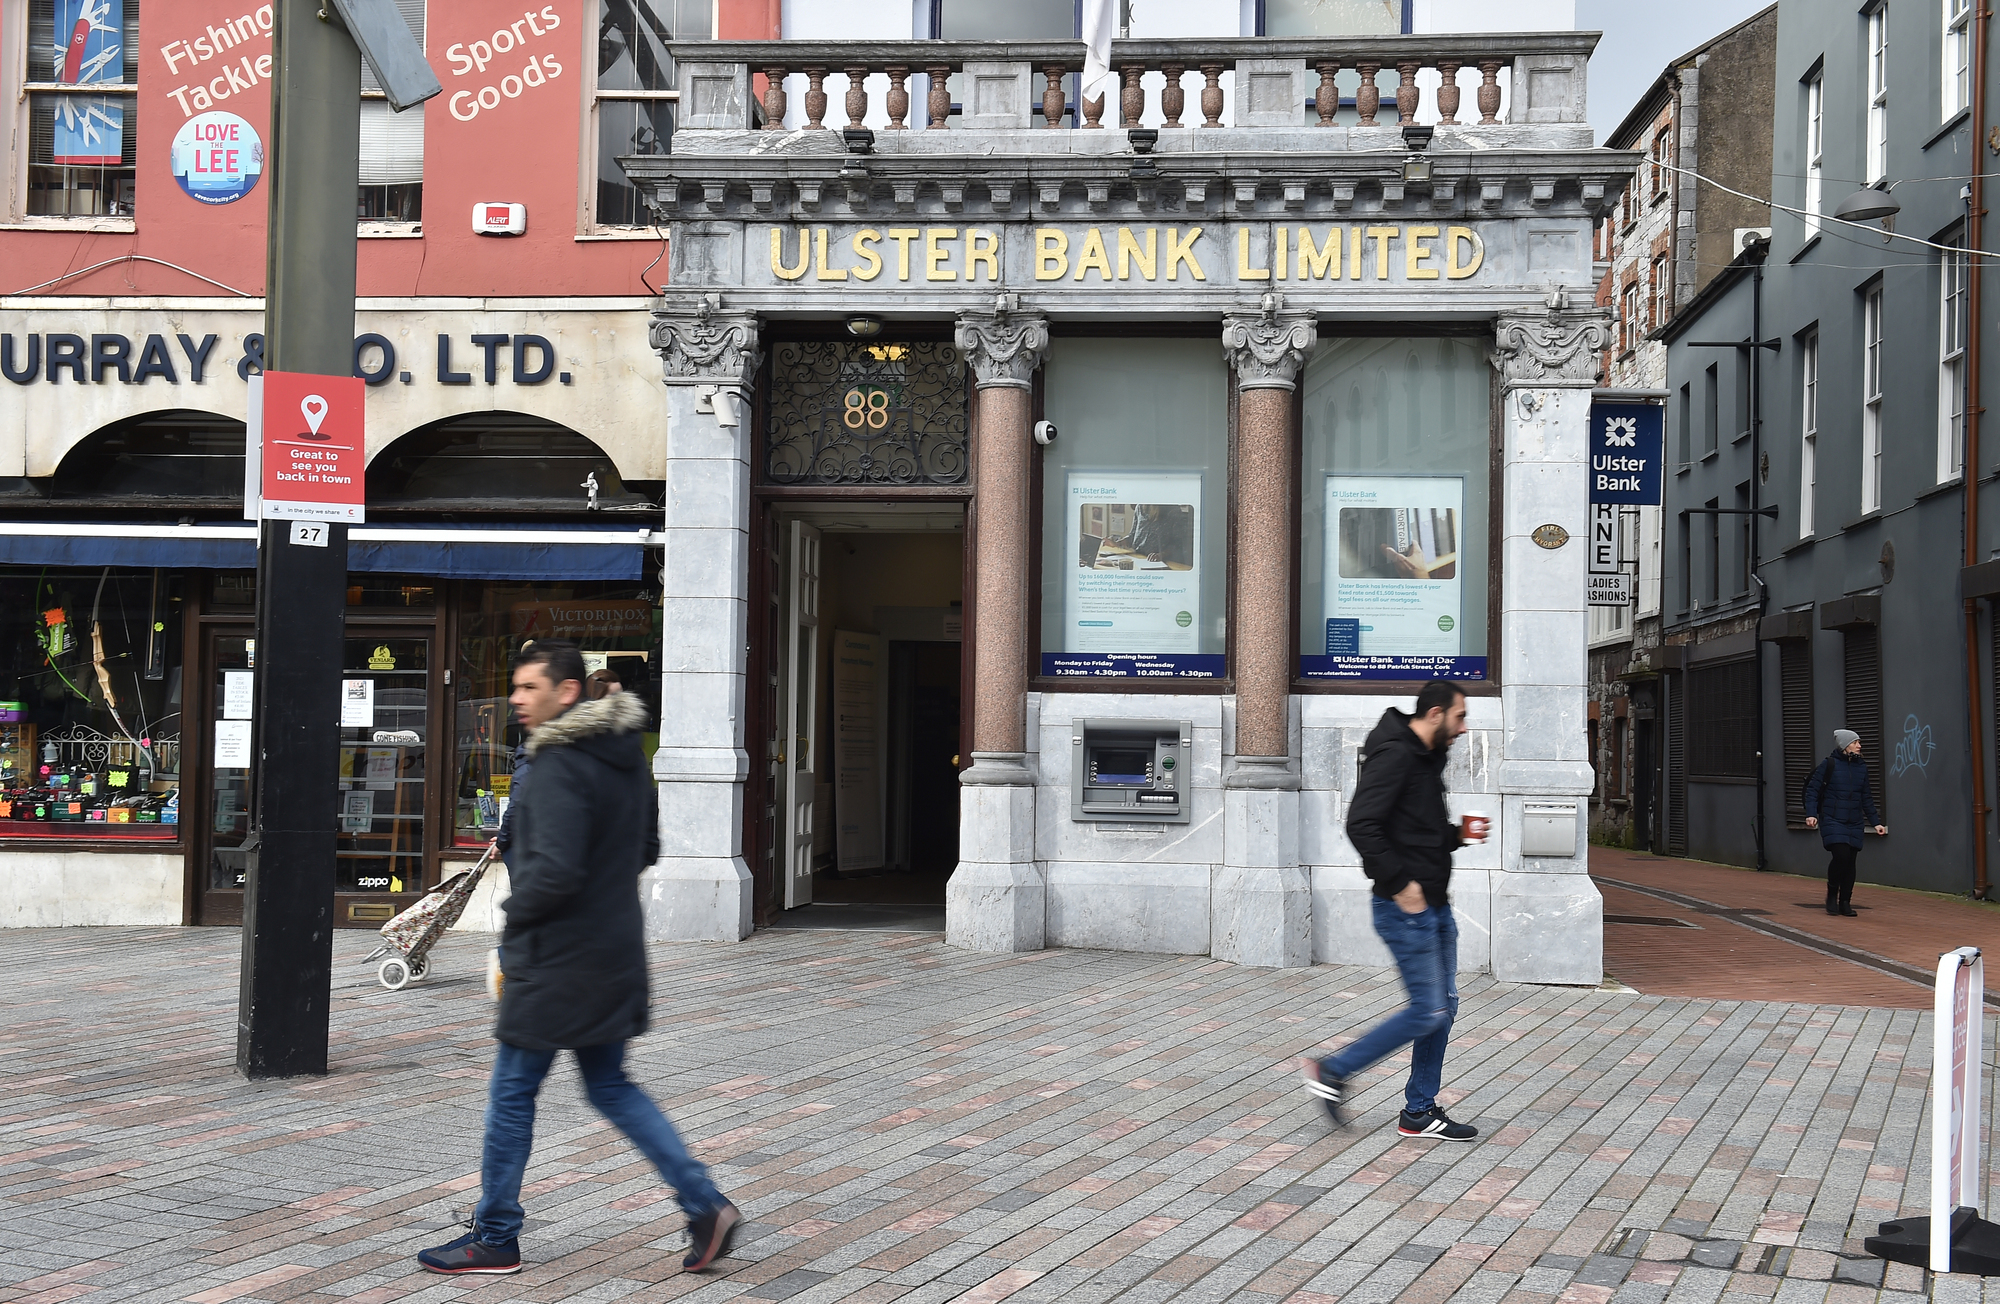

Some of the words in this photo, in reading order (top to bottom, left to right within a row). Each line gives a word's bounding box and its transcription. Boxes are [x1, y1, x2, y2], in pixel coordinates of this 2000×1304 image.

[160, 4, 273, 75] Fishing
[446, 5, 560, 76] Sports
[166, 54, 272, 117] Tackle
[449, 54, 562, 121] Goods
[196, 124, 239, 141] LOVE
[195, 150, 238, 172] LEE
[770, 228, 998, 281] ULSTER
[1035, 228, 1206, 281] BANK
[1238, 227, 1484, 280] LIMITED
[353, 333, 411, 383] O.
[438, 334, 571, 383] LTD.
[844, 390, 889, 429] 88
[290, 449, 322, 460] Great
[326, 451, 338, 460] to
[1593, 454, 1646, 471] Ulster
[292, 462, 312, 470] see
[315, 464, 336, 472] you
[277, 471, 305, 481] back
[308, 473, 319, 482] in
[322, 474, 351, 484] town
[1597, 474, 1640, 491] Bank
[300, 528, 320, 541] 27
[1398, 508, 1406, 552] MORTGAGE
[1535, 537, 1564, 547] HYDRANT
[1588, 578, 1620, 588] LADIES
[548, 608, 646, 621] VICTORINOX
[564, 625, 585, 633] Original
[1402, 656, 1433, 664] Ireland
[358, 877, 389, 888] zippo
